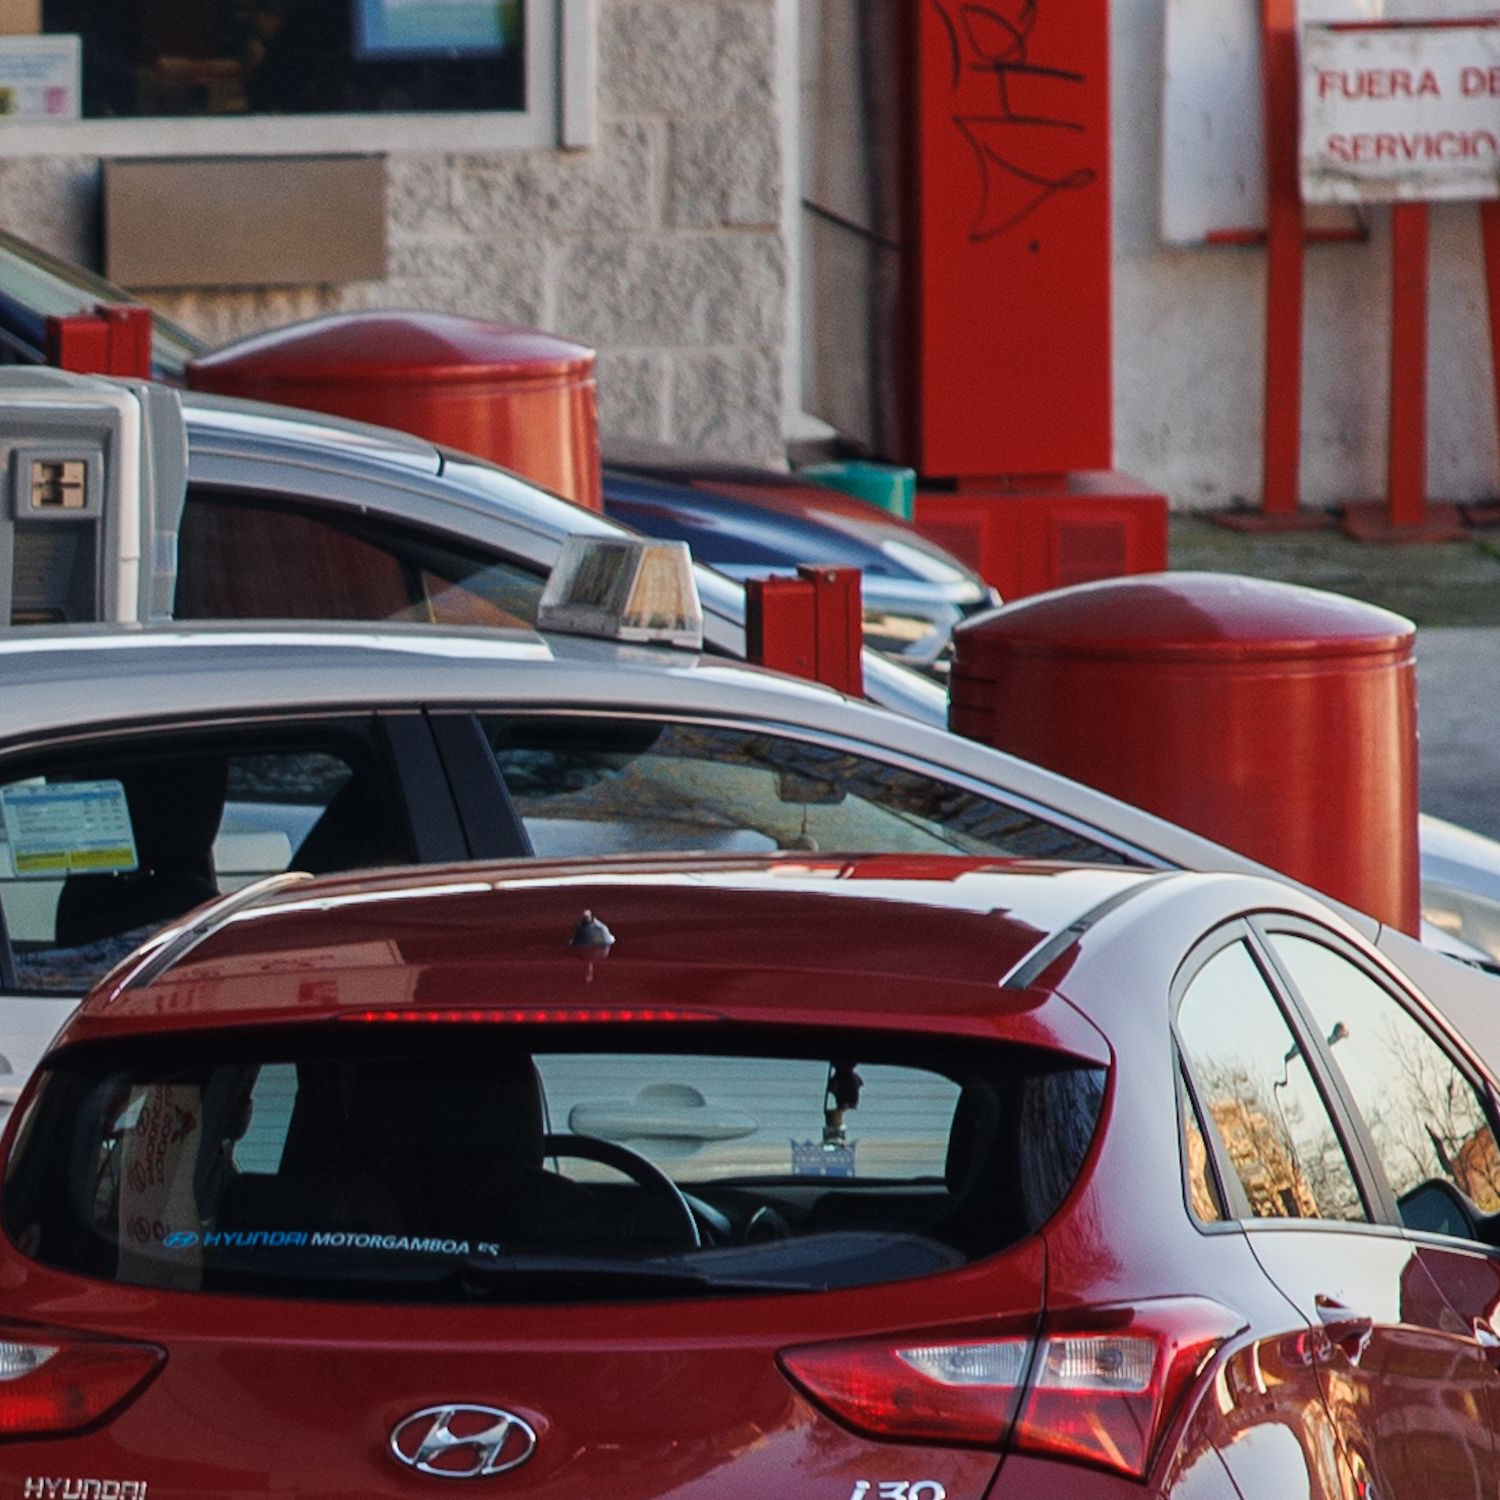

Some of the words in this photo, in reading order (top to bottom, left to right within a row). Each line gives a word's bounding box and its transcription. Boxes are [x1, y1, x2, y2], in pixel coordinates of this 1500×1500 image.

[1319, 69, 1440, 99] FUERA
[1328, 129, 1496, 161] SERVICIO
[203, 1231, 308, 1247] HYUNDAI
[311, 1233, 471, 1255] MOTORGAMBOA
